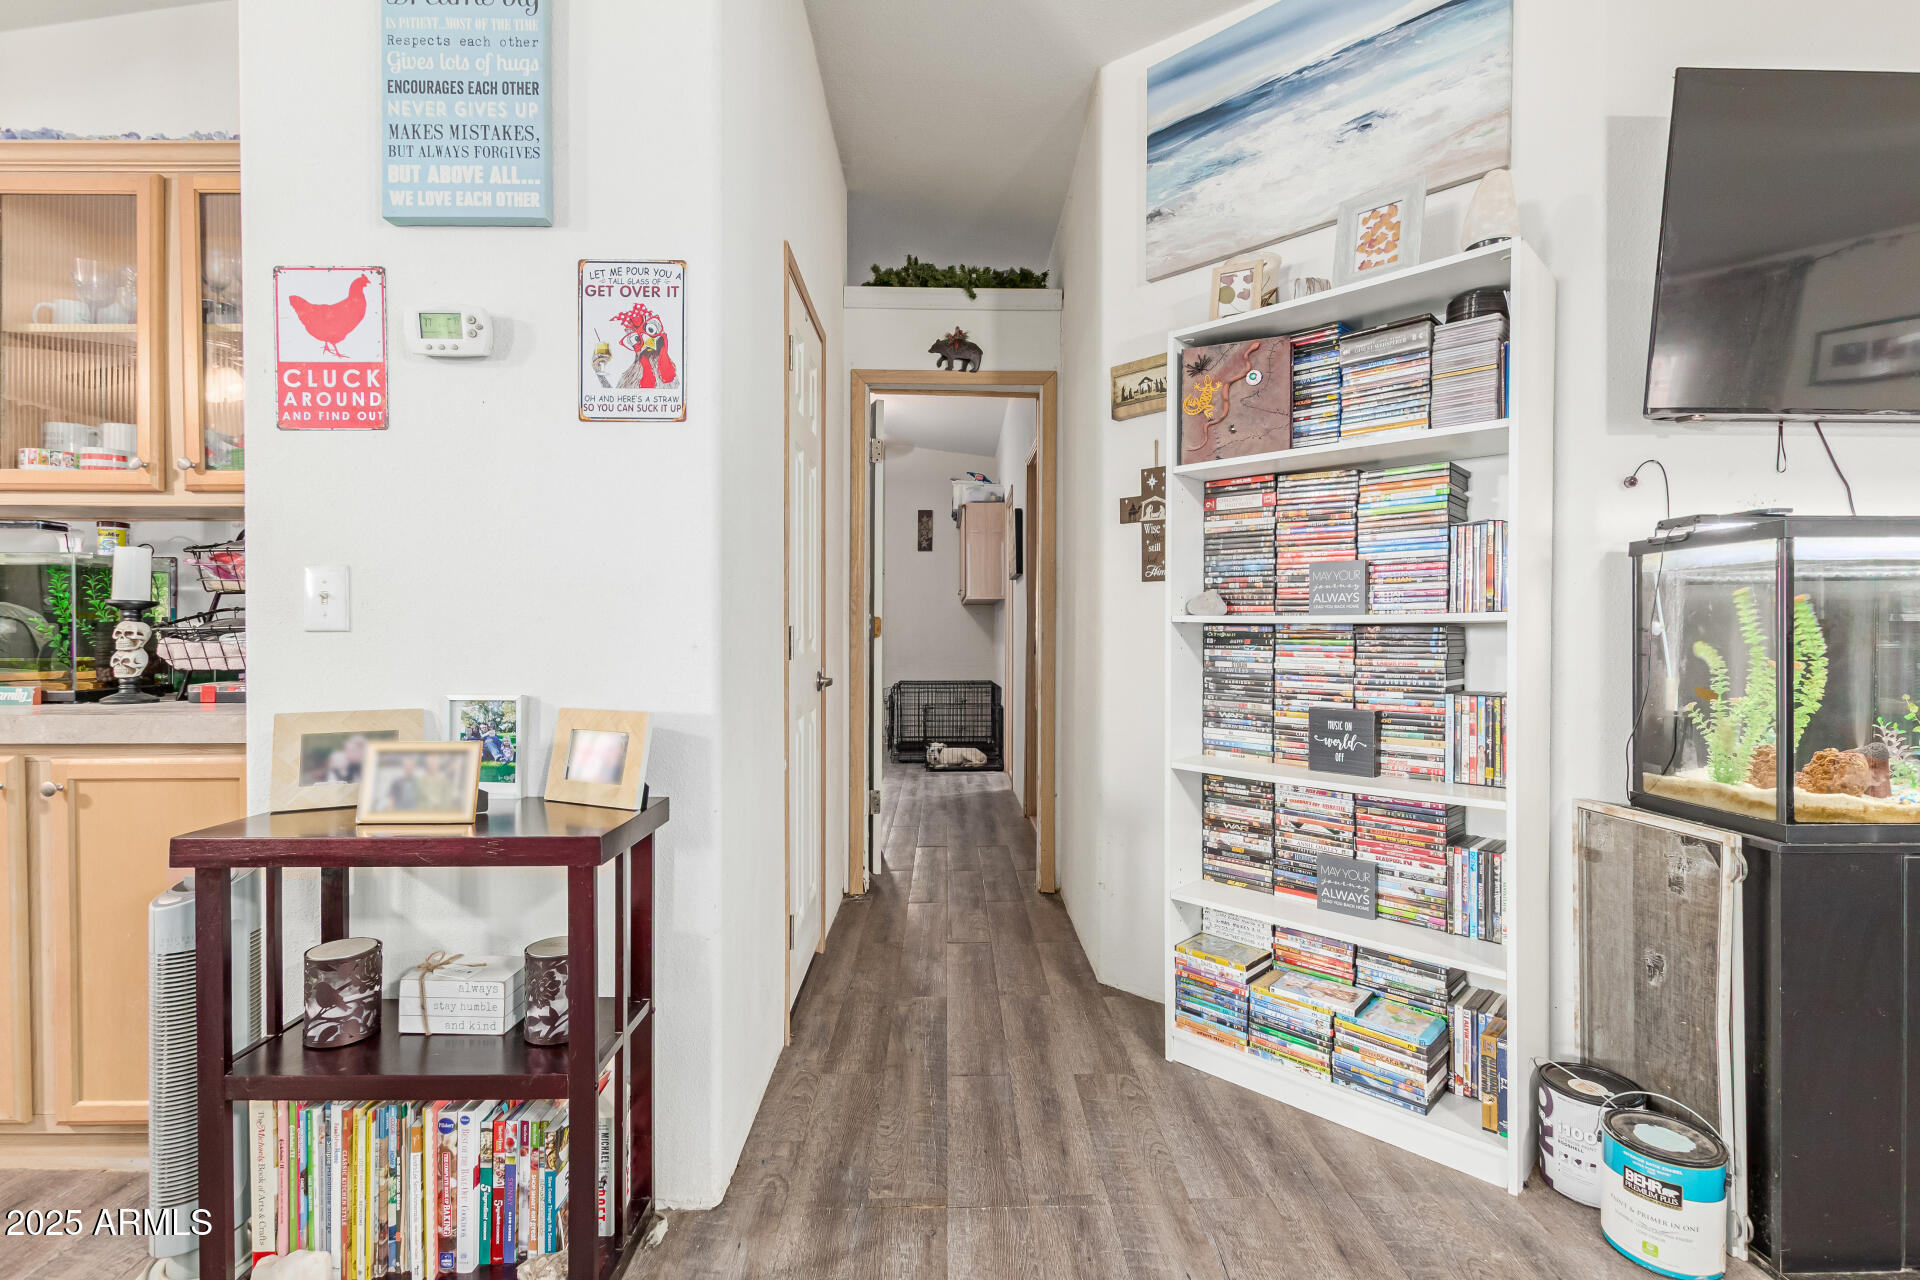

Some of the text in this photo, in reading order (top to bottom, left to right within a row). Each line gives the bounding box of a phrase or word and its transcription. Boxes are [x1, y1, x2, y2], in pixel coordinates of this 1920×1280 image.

[475, 18, 487, 31] OF
[490, 18, 511, 31] THE
[513, 18, 538, 31] TIME
[387, 34, 539, 48] Respects each other
[386, 51, 539, 77] Gives lots of hugs
[387, 80, 539, 96] ENCOURAGES EACH OTHER
[387, 100, 538, 118] NEVER GIVES UP
[388, 123, 540, 144] MAKES MISTAKES,
[388, 145, 540, 159] BUT ALWAYS FORGIVES
[387, 164, 541, 185] BUT ABOVE ALL...
[389, 190, 541, 208] WE LOVE EACH OTHER
[589, 267, 682, 281] LET ME POUR YOU A
[608, 277, 623, 285] TALL
[627, 277, 648, 285] GLASS
[584, 285, 680, 298] GET OVER IT
[283, 369, 380, 388] CLUCK
[283, 391, 382, 407] AROUND
[598, 395, 615, 403] AND
[617, 395, 643, 403] HERE'S
[645, 395, 650, 403] A
[653, 395, 680, 403] STRAW
[583, 403, 682, 412] SO YOU CAN SUCK IT UP
[282, 411, 383, 421] AND FIND OUT
[1143, 523, 1161, 534] Wise
[1148, 542, 1161, 552] still
[1312, 569, 1361, 581] MAY YOUR
[1312, 592, 1360, 604] ALWAYS
[1327, 720, 1353, 731] MUSIC ON
[1314, 733, 1367, 751] world
[1335, 752, 1345, 763] OFF
[1223, 822, 1249, 832] WAR
[1375, 856, 1403, 865] DEADPOOL
[1320, 865, 1371, 883] MAY YOUR
[1321, 887, 1370, 905] ALWAYS
[458, 983, 499, 996] always
[433, 1001, 498, 1013] stay humble
[444, 1020, 497, 1031] and kind
[257, 1112, 265, 1125] The
[438, 1122, 456, 1130] Pillsbury
[257, 1124, 266, 1163] Michaels
[601, 1132, 609, 1164] MICHAEL
[1558, 1139, 1584, 1154] EGGSHELL
[257, 1164, 266, 1184] Book
[1625, 1168, 1663, 1194] BEHR
[258, 1185, 266, 1194] of
[480, 1184, 491, 1193] 5
[1625, 1180, 1679, 1206] PREMIUM PLUS
[258, 1195, 267, 1212] Arts
[443, 1204, 451, 1236] BAKING
[1637, 1211, 1668, 1227] PRIMER
[1671, 1222, 1680, 1230] IN
[1682, 1225, 1700, 1233] ONE
[258, 1221, 267, 1246] Crafts
